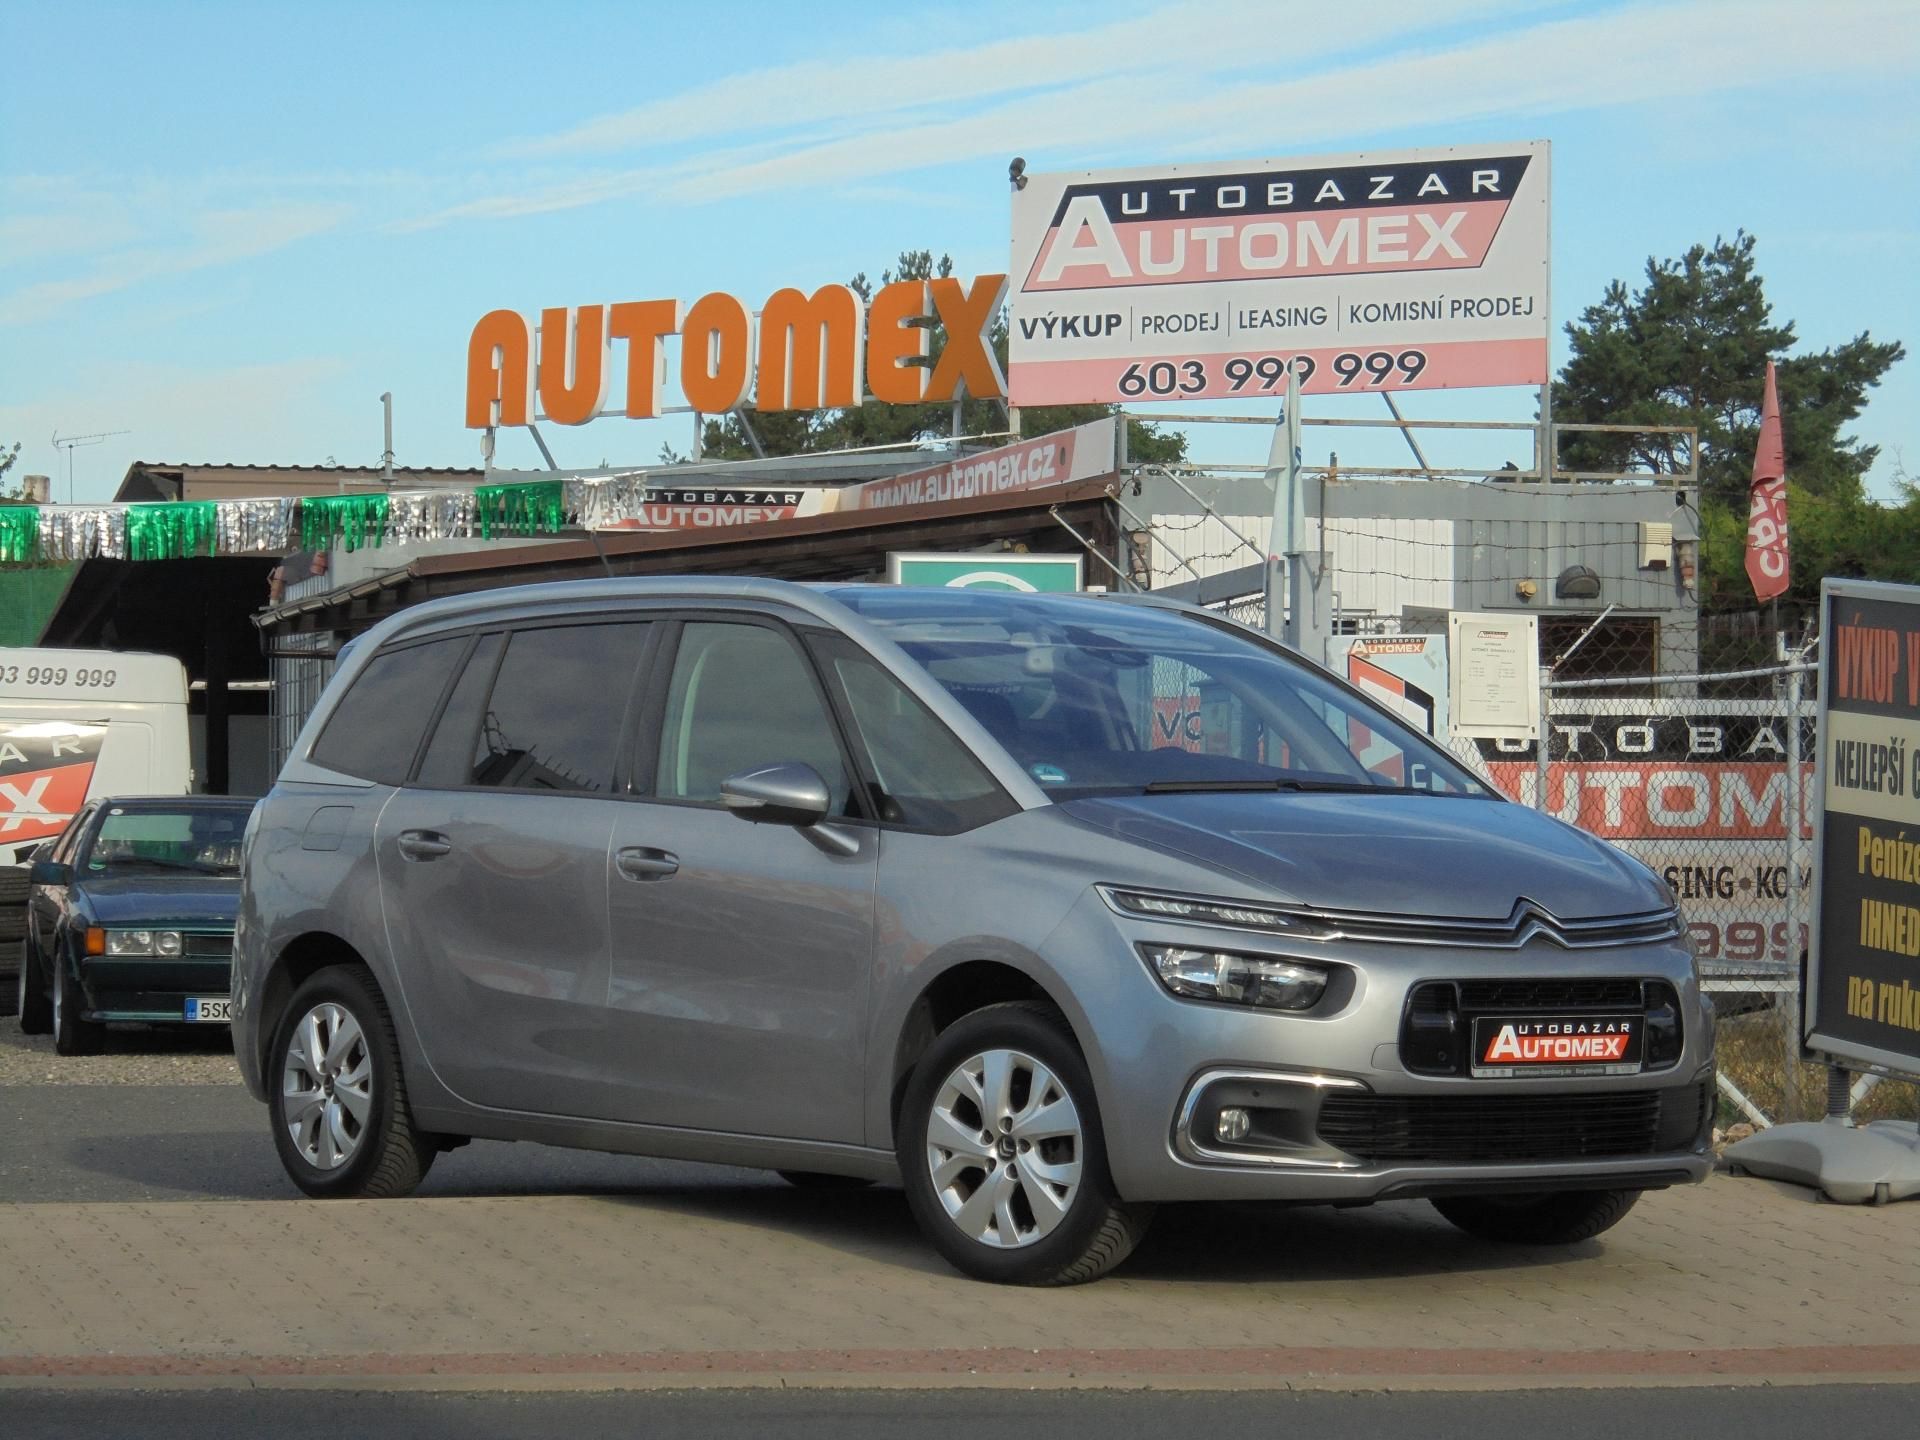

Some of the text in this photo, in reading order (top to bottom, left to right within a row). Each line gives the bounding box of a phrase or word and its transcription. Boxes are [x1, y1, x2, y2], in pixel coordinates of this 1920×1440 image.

[1036, 194, 1470, 284] AUTOMEX
[1018, 311, 1122, 340] VÝKUP
[1141, 312, 1220, 335] PRODEJ
[1238, 306, 1328, 330] LEASING
[1350, 294, 1534, 324] KOMISNÍ PRODEJ
[466, 273, 1010, 429] AUTOMEX
[1117, 349, 1428, 397] 603 999 999
[1350, 640, 1421, 654] AUTOMEX
[1837, 611, 1899, 704] VÝKUP
[26, 666, 68, 687] 999
[75, 668, 117, 688] 999
[1834, 736, 1906, 796] NEJLEPŠÍ
[1651, 866, 1734, 899] SING
[1860, 898, 1920, 957] IHNED
[1847, 975, 1873, 1020] na
[1490, 1025, 1620, 1058] AUTOMEX
